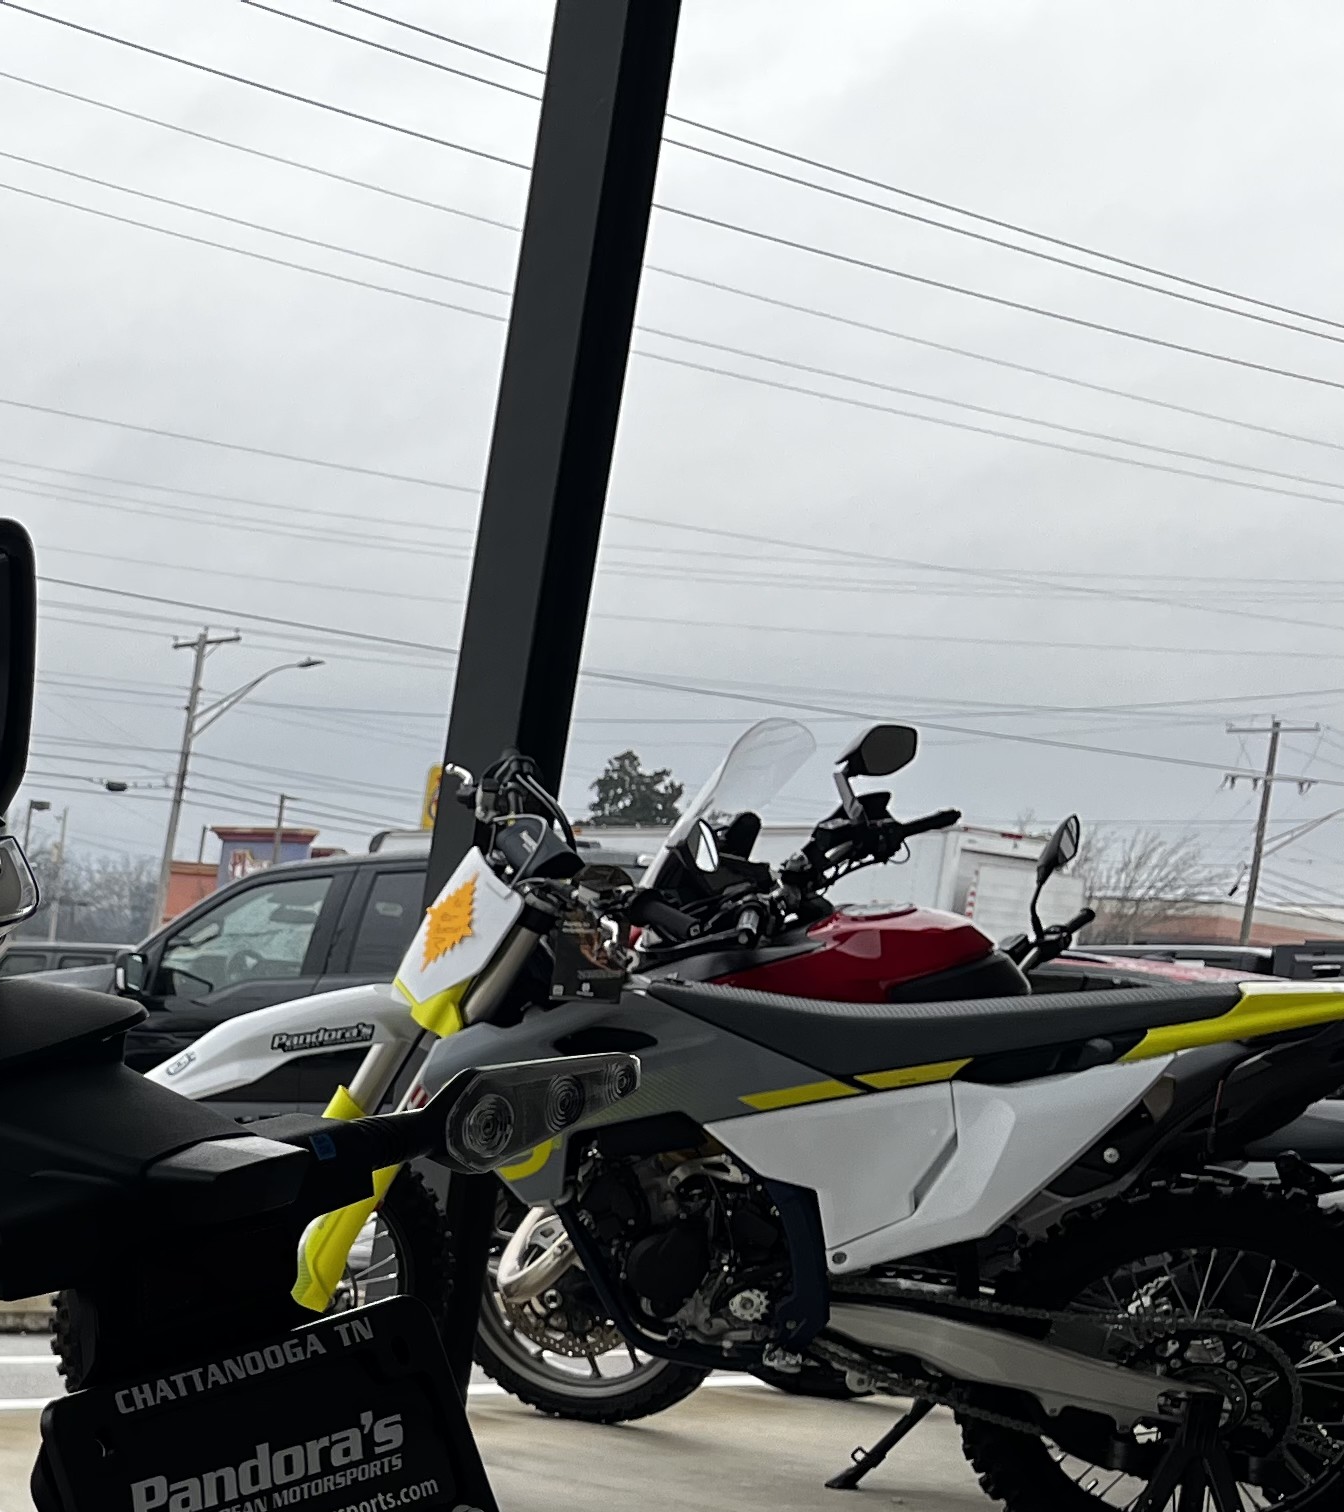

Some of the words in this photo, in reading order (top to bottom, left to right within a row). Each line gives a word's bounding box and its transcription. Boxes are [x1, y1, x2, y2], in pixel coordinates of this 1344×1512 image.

[273, 1022, 375, 1049] Pandora's
[115, 1332, 326, 1415] CHATTANOOGA
[335, 1316, 375, 1347] TN
[271, 1453, 403, 1509] MOTORSPORTS
